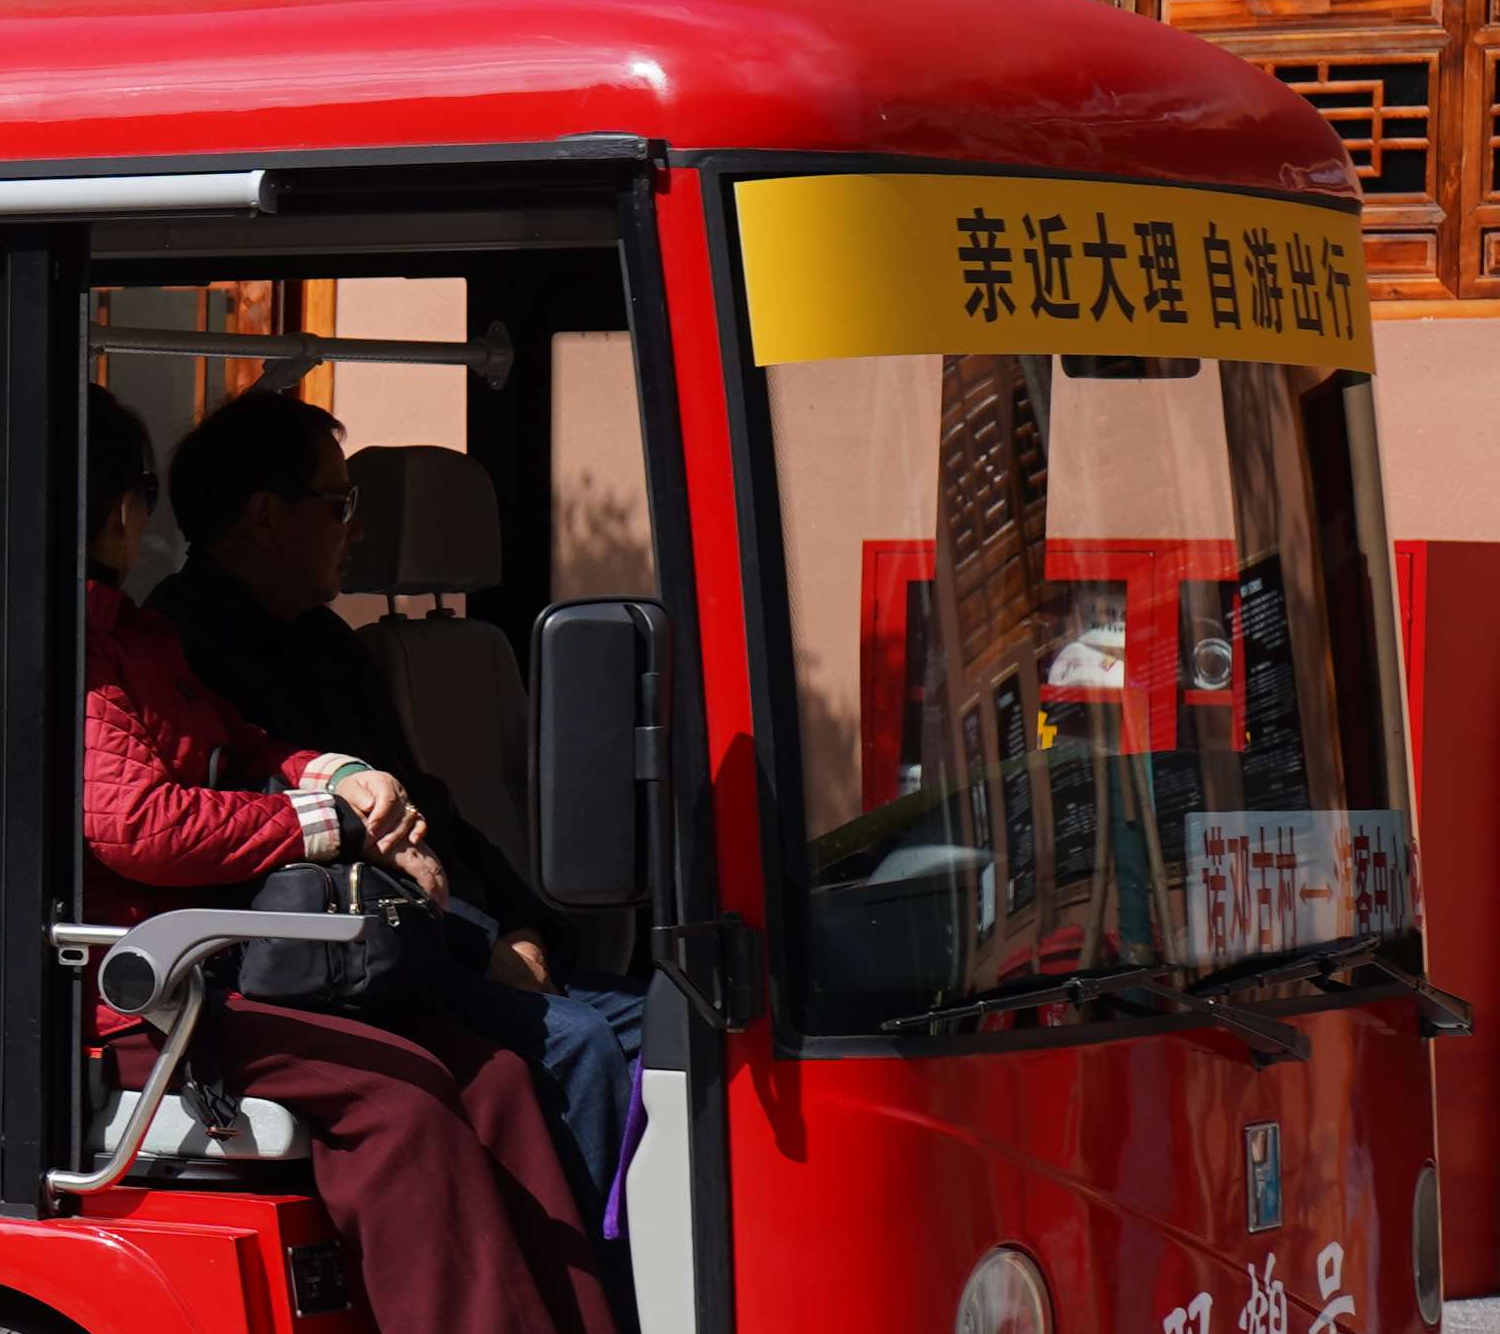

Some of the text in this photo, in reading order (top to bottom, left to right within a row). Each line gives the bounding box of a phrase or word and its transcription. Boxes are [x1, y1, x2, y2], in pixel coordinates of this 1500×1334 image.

[956, 207, 1355, 341] 亲近大理 自游出行
